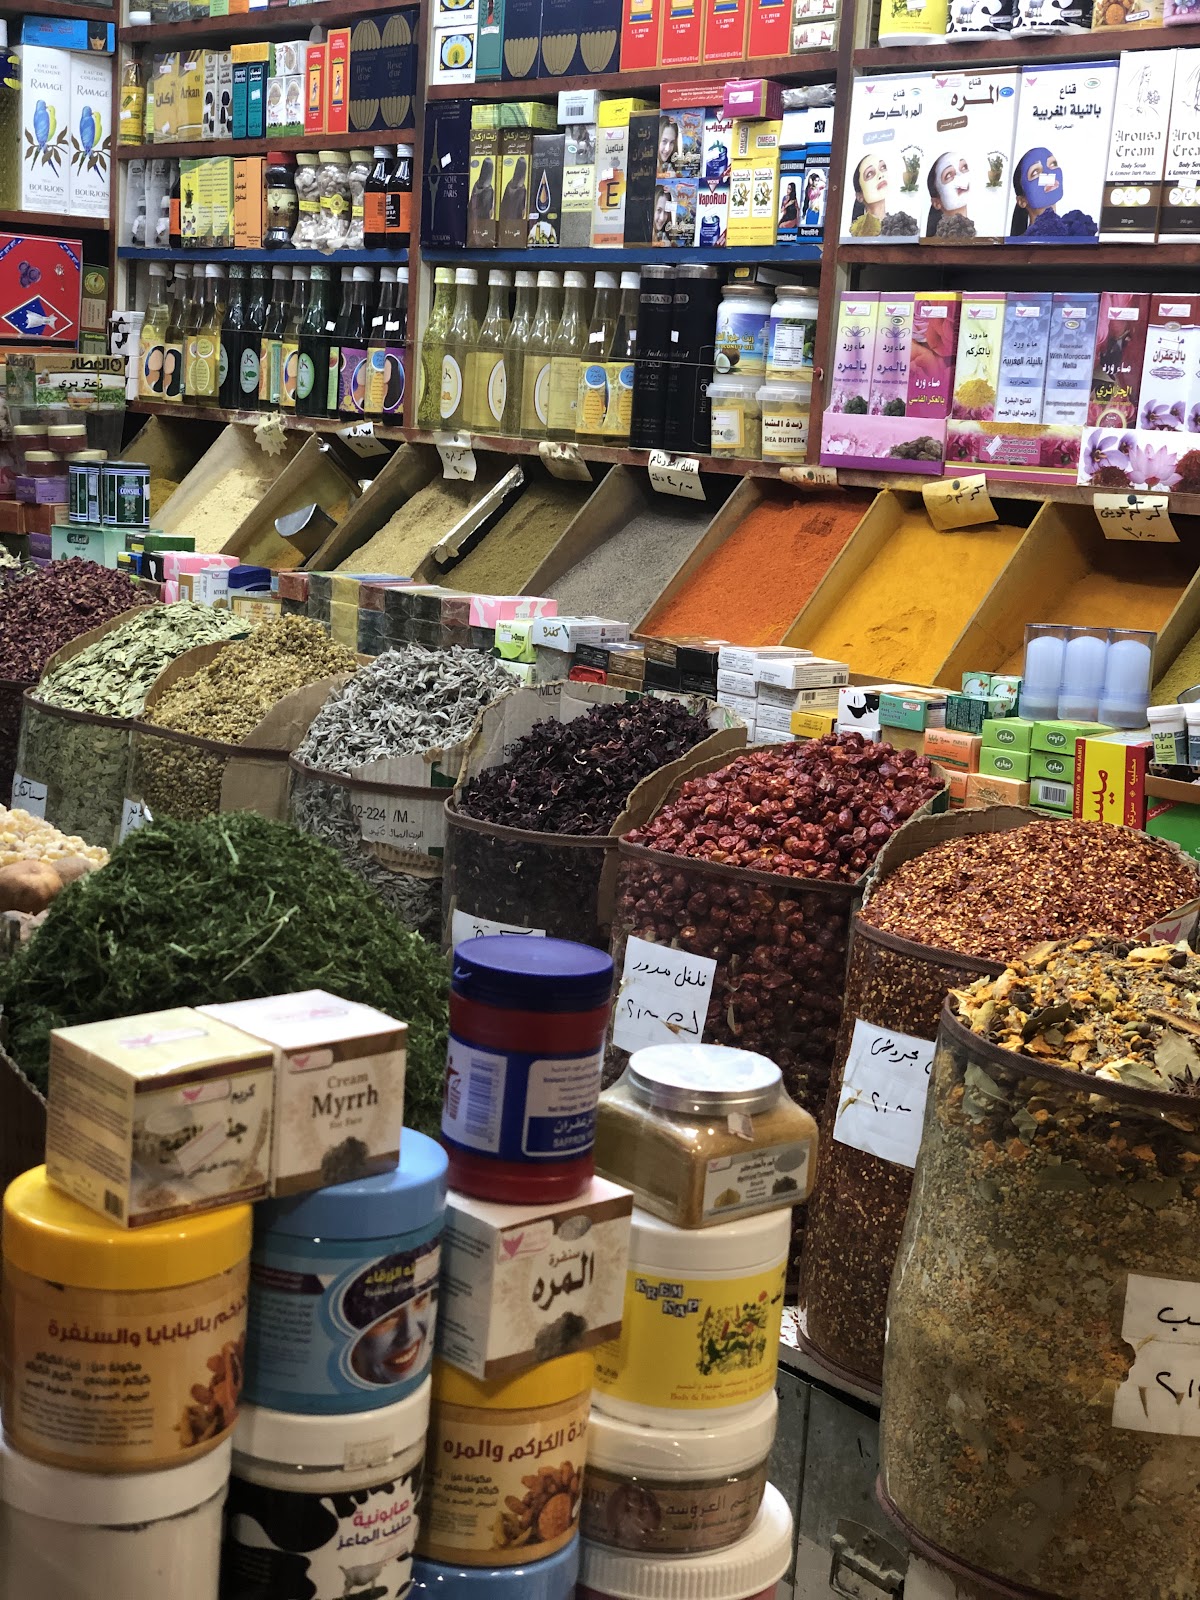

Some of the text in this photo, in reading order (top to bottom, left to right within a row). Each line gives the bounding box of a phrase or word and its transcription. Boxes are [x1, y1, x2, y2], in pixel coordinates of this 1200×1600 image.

[34, 68, 61, 76] COLOGNE
[80, 74, 106, 82] COLOGNE
[30, 78, 64, 92] RAMAGE
[968, 77, 982, 90] قناع
[76, 84, 110, 98] RAMAGE
[180, 86, 200, 100] Arkan
[892, 89, 906, 102] قناع
[1059, 83, 1076, 100] قناع
[1032, 102, 1101, 120] بالنيلة المغربية
[605, 144, 624, 154] فيتامين
[29, 183, 64, 193] BOURJOIS
[74, 188, 110, 198] BOURJOIS
[443, 189, 457, 198] PARIS
[606, 181, 620, 207] E
[968, 332, 978, 340] ورد
[843, 343, 853, 352] ورد
[882, 344, 894, 353] ورد
[1013, 340, 1038, 349] ماء ورد
[965, 346, 991, 358] بالكركم
[1049, 352, 1063, 360] With
[70, 358, 110, 371] العطار
[1002, 356, 1043, 368] بالنيلة المغربية
[1102, 362, 1132, 375] ماء ورد
[58, 377, 104, 390] زعتر بري
[915, 376, 941, 389] ماء ورد
[1096, 384, 1133, 398] الجزائري
[778, 436, 802, 444] BUTTER
[120, 487, 141, 496] CONSUL
[674, 966, 706, 987] فلفل
[326, 1071, 369, 1090] Cream
[311, 1084, 380, 1118] Myrrh
[531, 1250, 595, 1311] المره
[635, 1278, 684, 1300] KREM
[662, 1298, 700, 1318] KAP
[48, 1319, 142, 1348] والسنفرة
[443, 1429, 564, 1463] الكركم والمره
[353, 1499, 410, 1528] صابونية
[336, 1525, 380, 1551] الماعز
